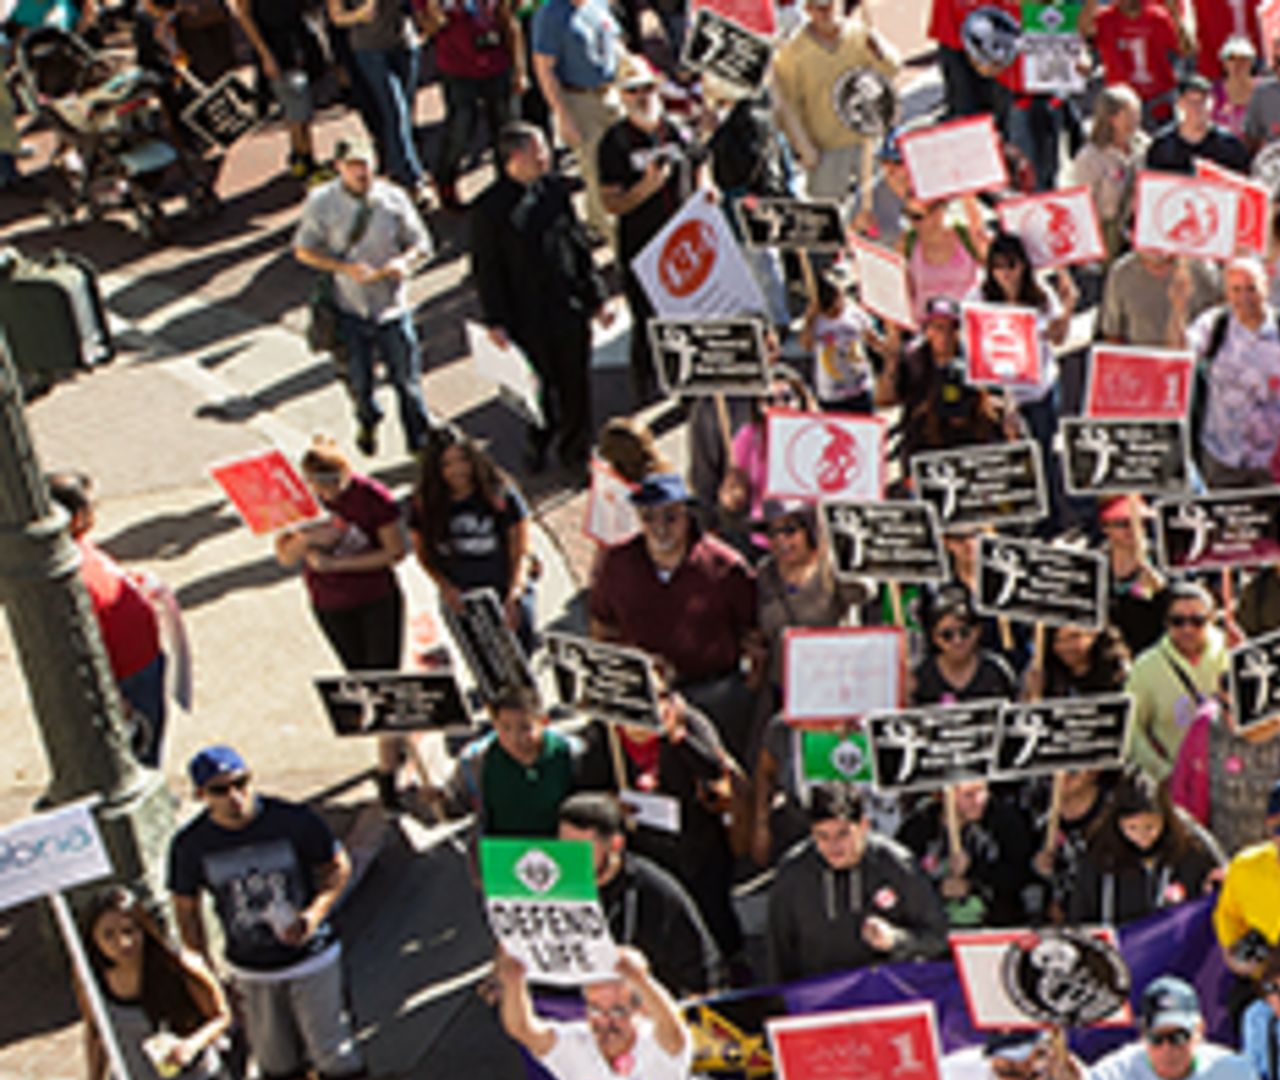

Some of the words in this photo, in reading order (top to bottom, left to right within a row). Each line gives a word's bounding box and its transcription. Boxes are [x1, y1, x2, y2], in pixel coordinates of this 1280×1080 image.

[491, 903, 603, 939] DEFEND
[530, 943, 594, 973] LIFE
[888, 1030, 924, 1079] 1
